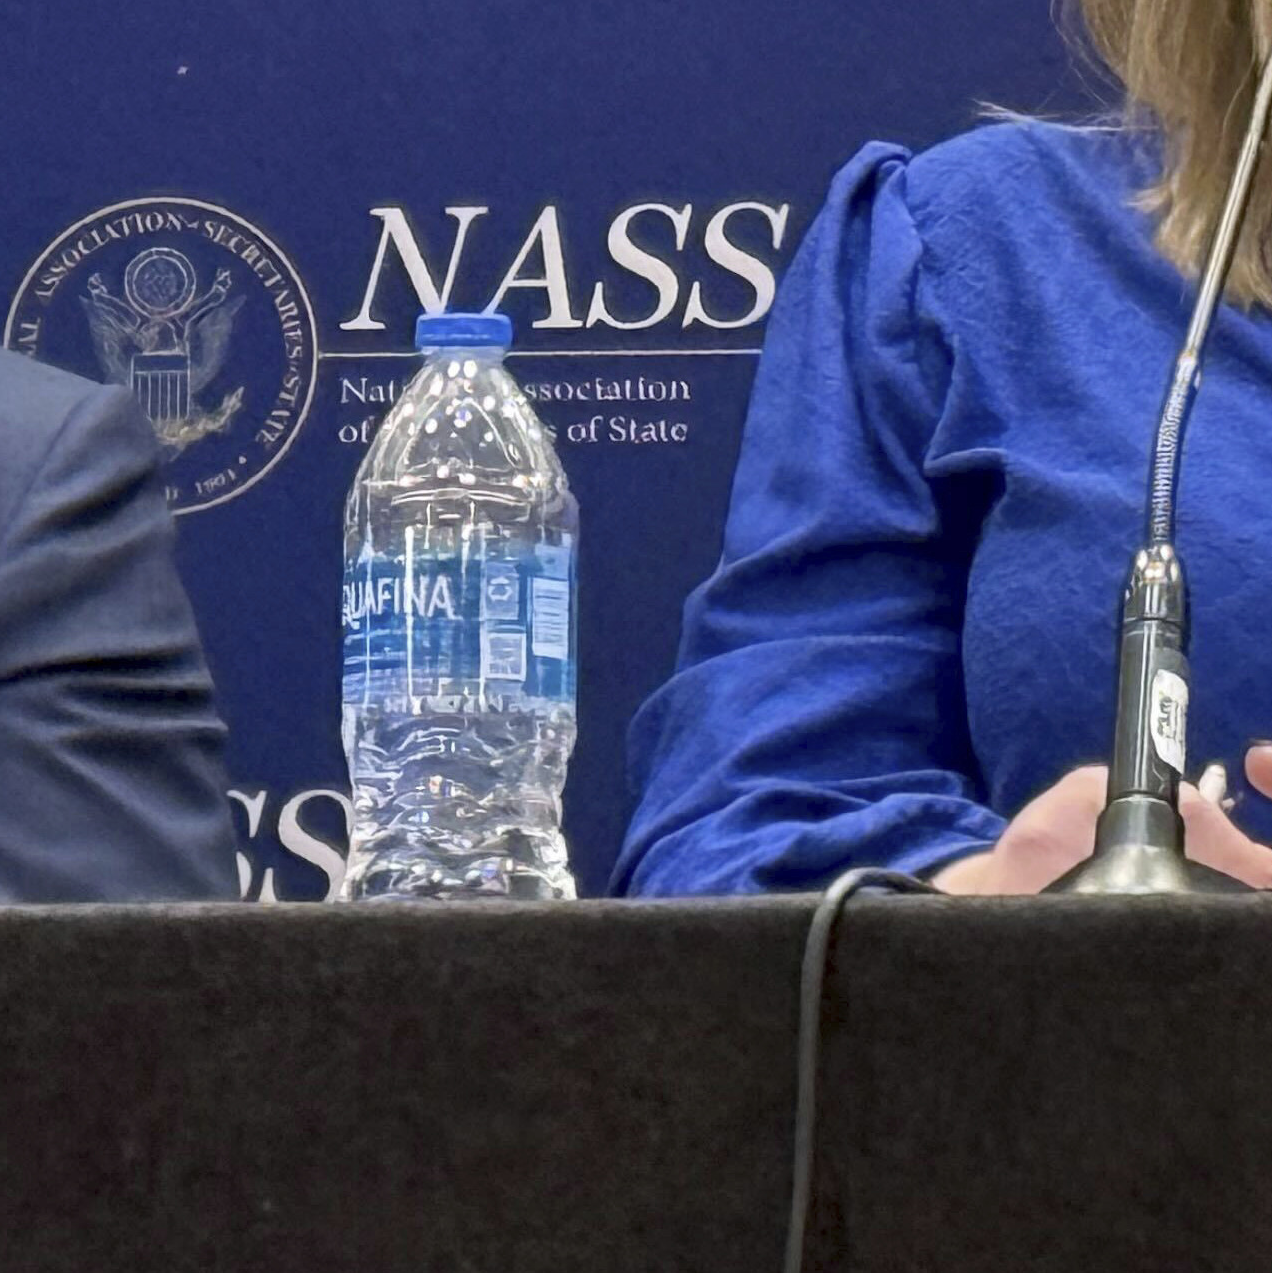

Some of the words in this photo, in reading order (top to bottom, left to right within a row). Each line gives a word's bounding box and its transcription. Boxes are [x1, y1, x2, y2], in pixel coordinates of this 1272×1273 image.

[340, 203, 788, 329] NASS
[526, 377, 691, 401] ssociation
[568, 416, 603, 442] of
[609, 416, 687, 443] State
